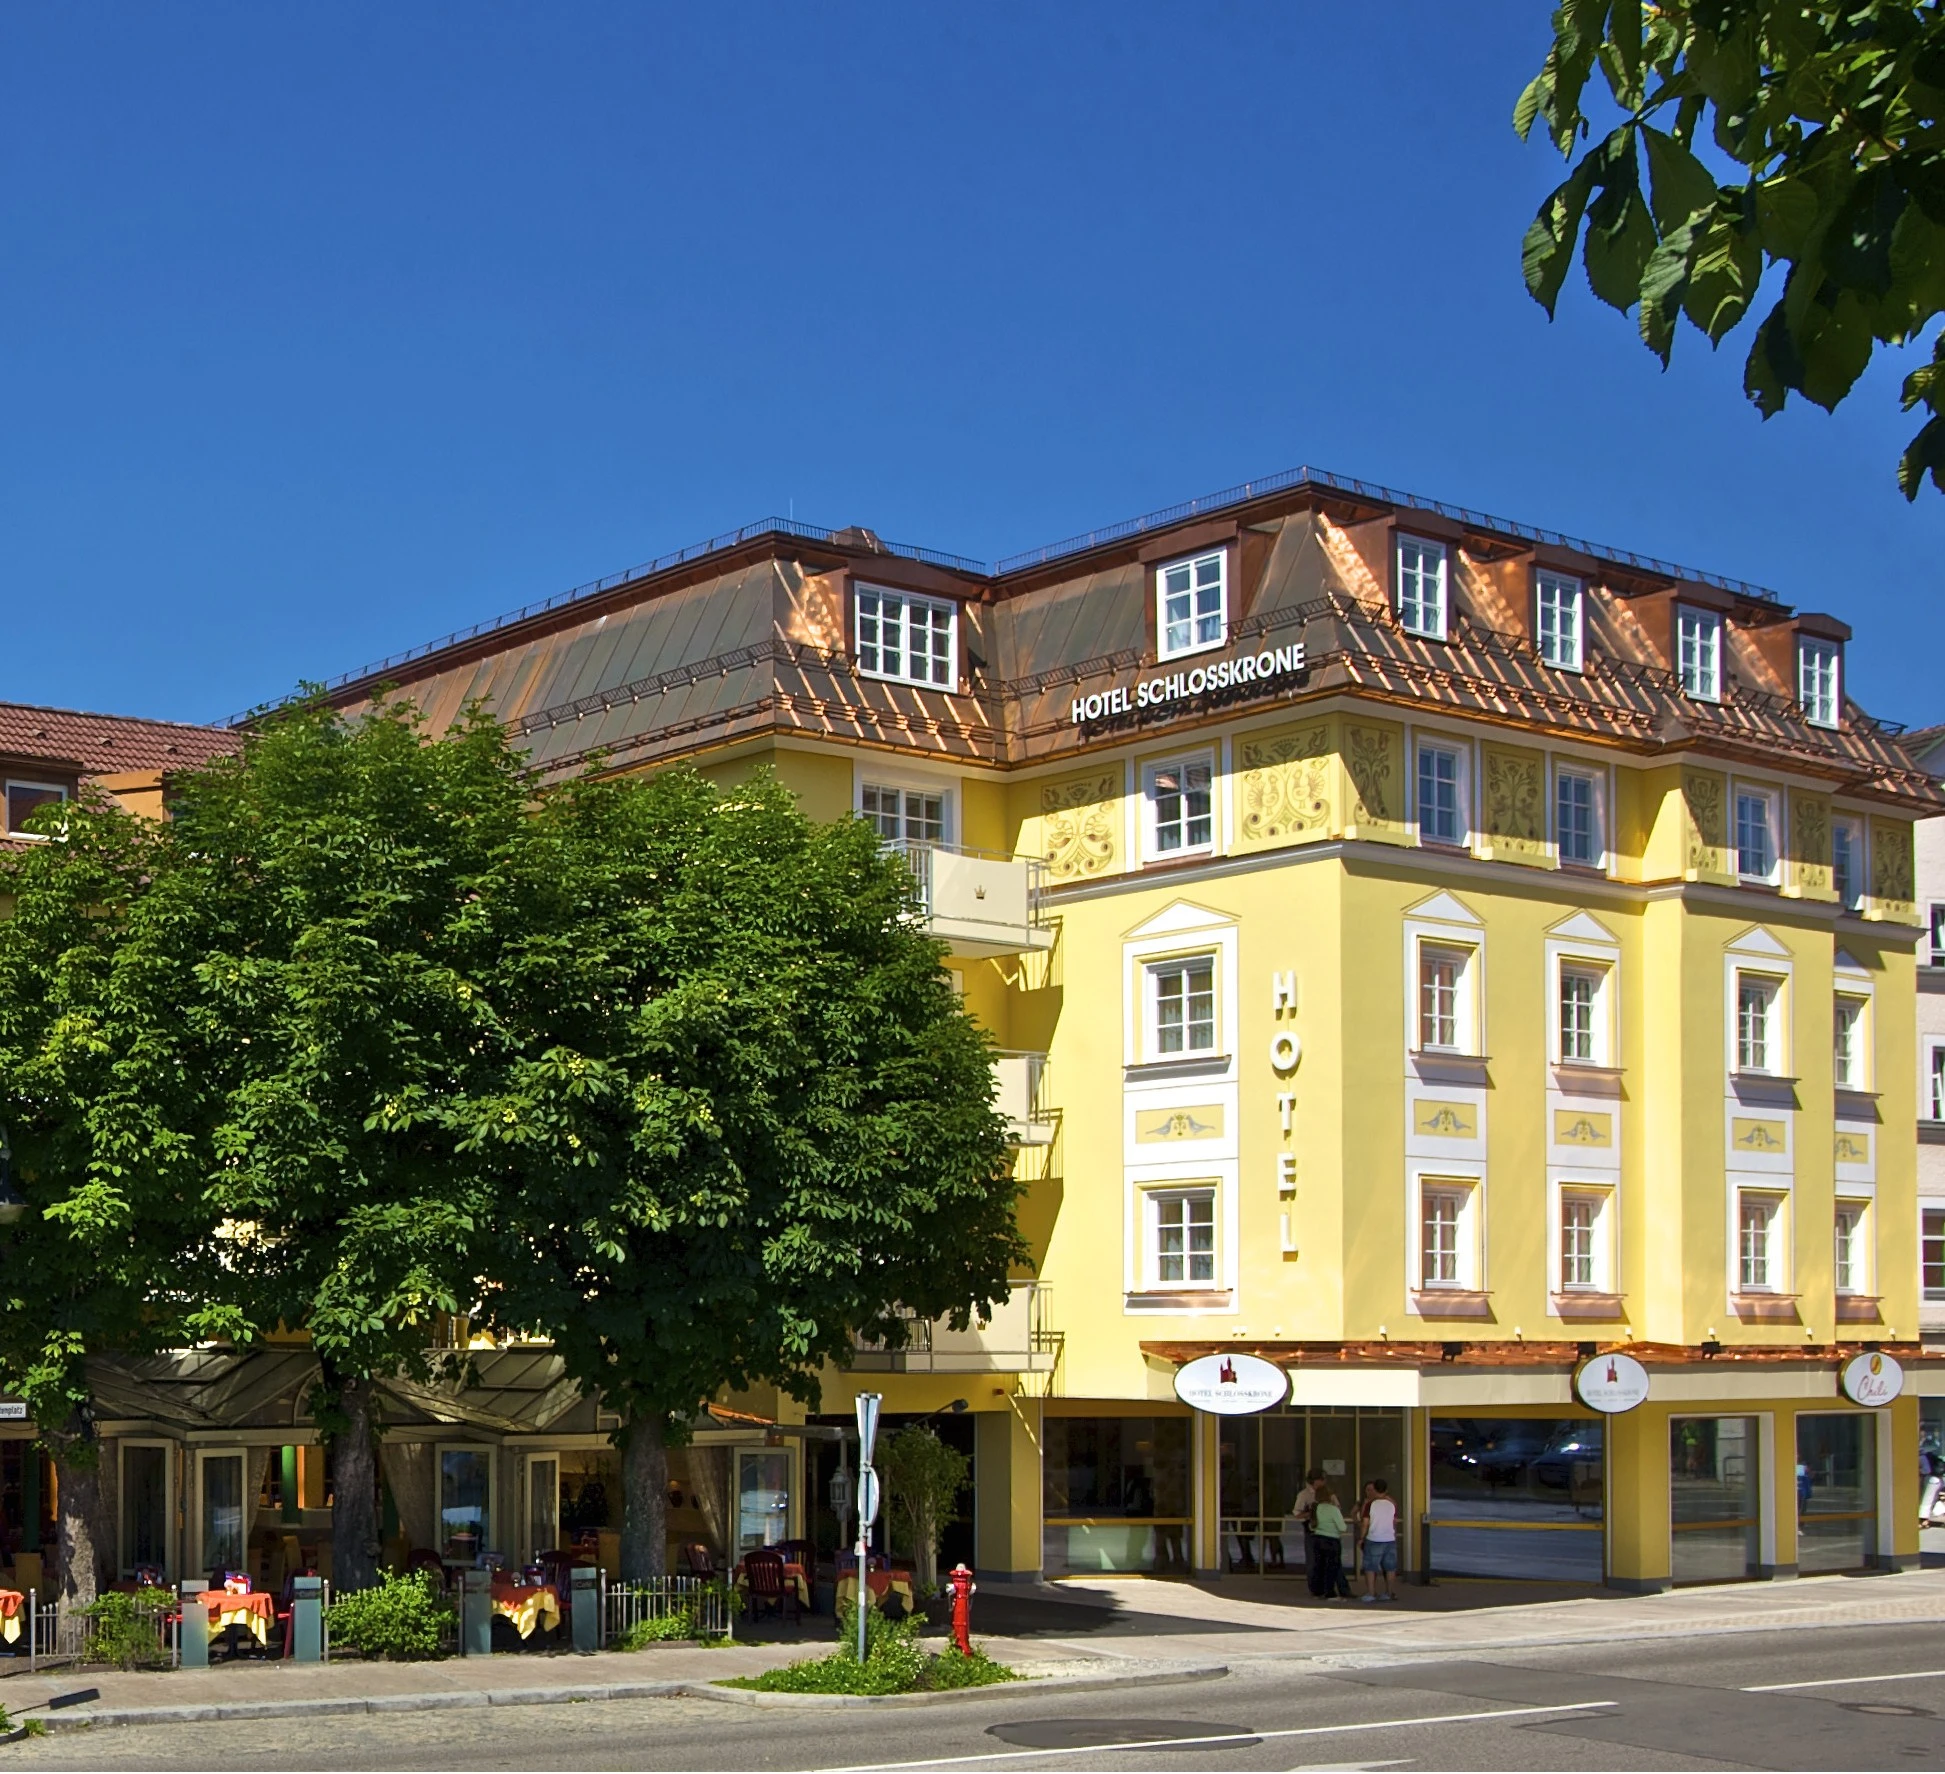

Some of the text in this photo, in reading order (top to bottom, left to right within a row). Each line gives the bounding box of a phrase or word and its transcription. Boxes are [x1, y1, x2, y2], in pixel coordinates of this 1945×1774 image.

[1071, 643, 1305, 724] HOTEL SCHLOSSKRONE
[1270, 970, 1301, 1252] HOTEL
